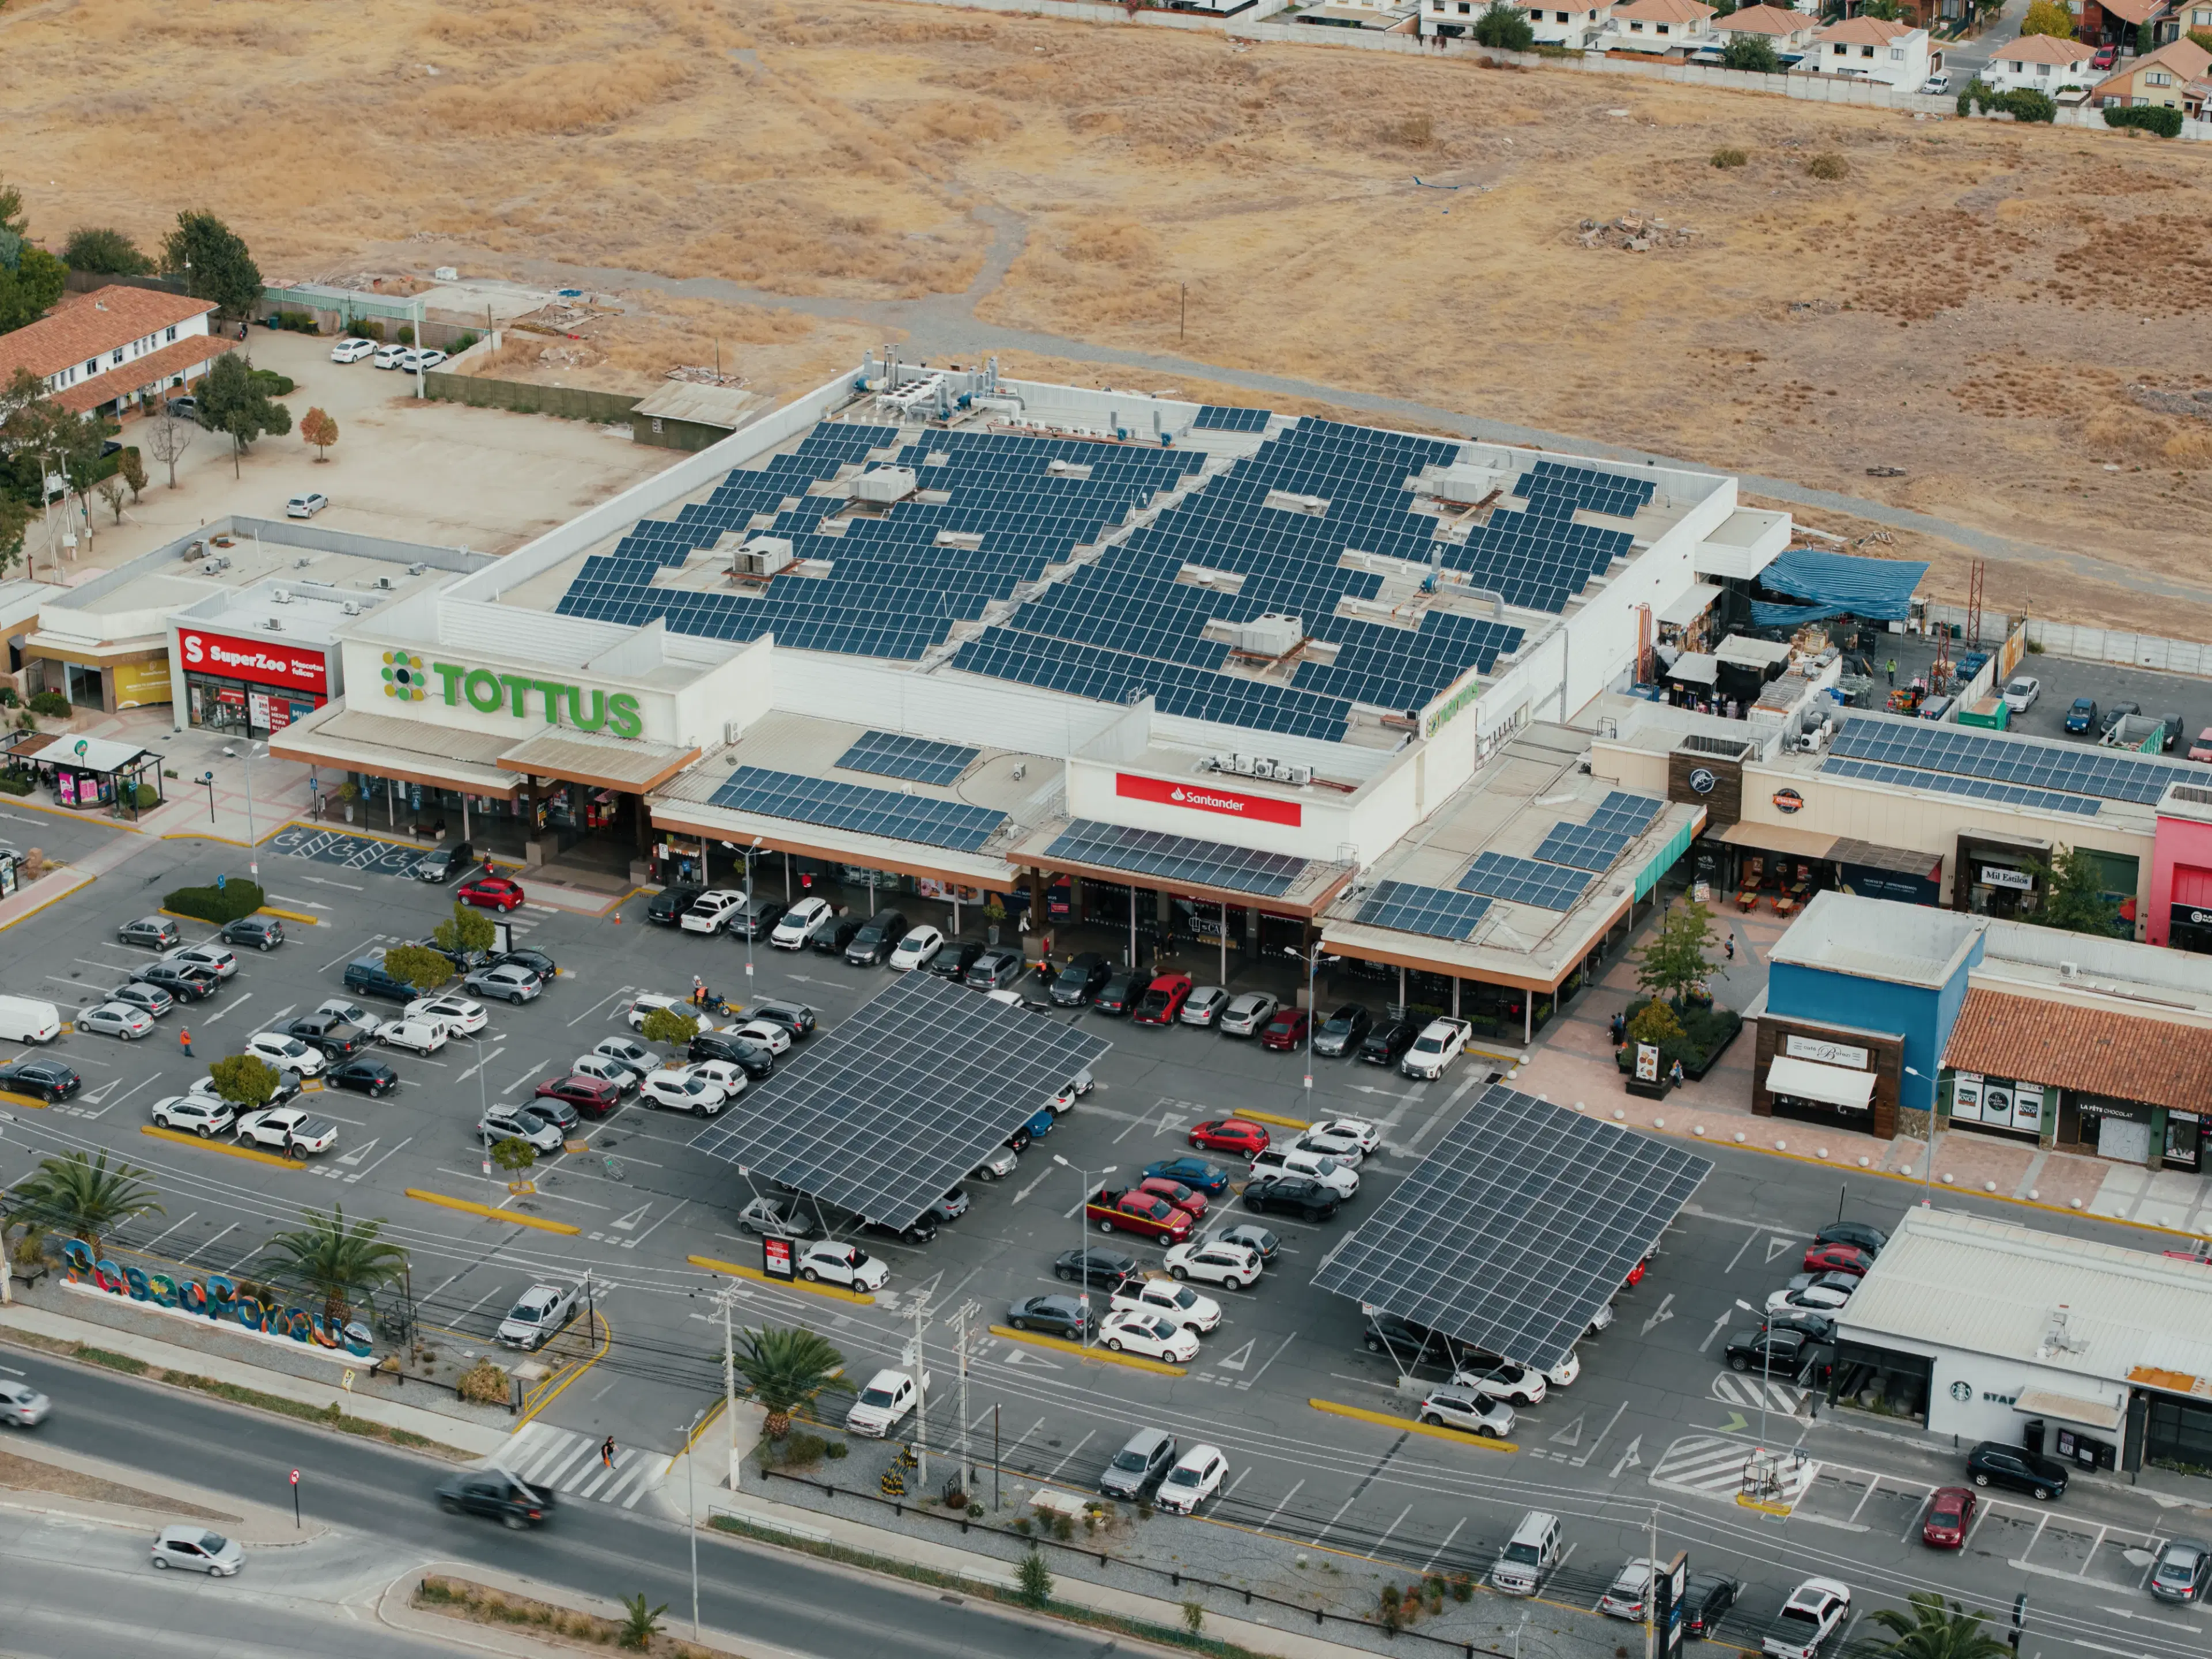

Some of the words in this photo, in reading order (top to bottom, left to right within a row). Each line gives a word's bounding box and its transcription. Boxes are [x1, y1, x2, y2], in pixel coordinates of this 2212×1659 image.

[185, 635, 203, 662] S
[210, 646, 286, 672] SuperZoo
[291, 660, 324, 672] Mascotas
[291, 668, 314, 677] felices
[433, 662, 642, 738] TOTTUS
[1187, 792, 1244, 811] Santander
[1986, 870, 2000, 880] Mil
[2003, 873, 2028, 885] Estilos
[1885, 882, 1917, 891] ORPRENDEREMOS
[1817, 1045, 1851, 1060] Berezi
[2089, 1105, 2103, 1113] FÊTE
[2104, 1108, 2134, 1118] CHOCOLAT
